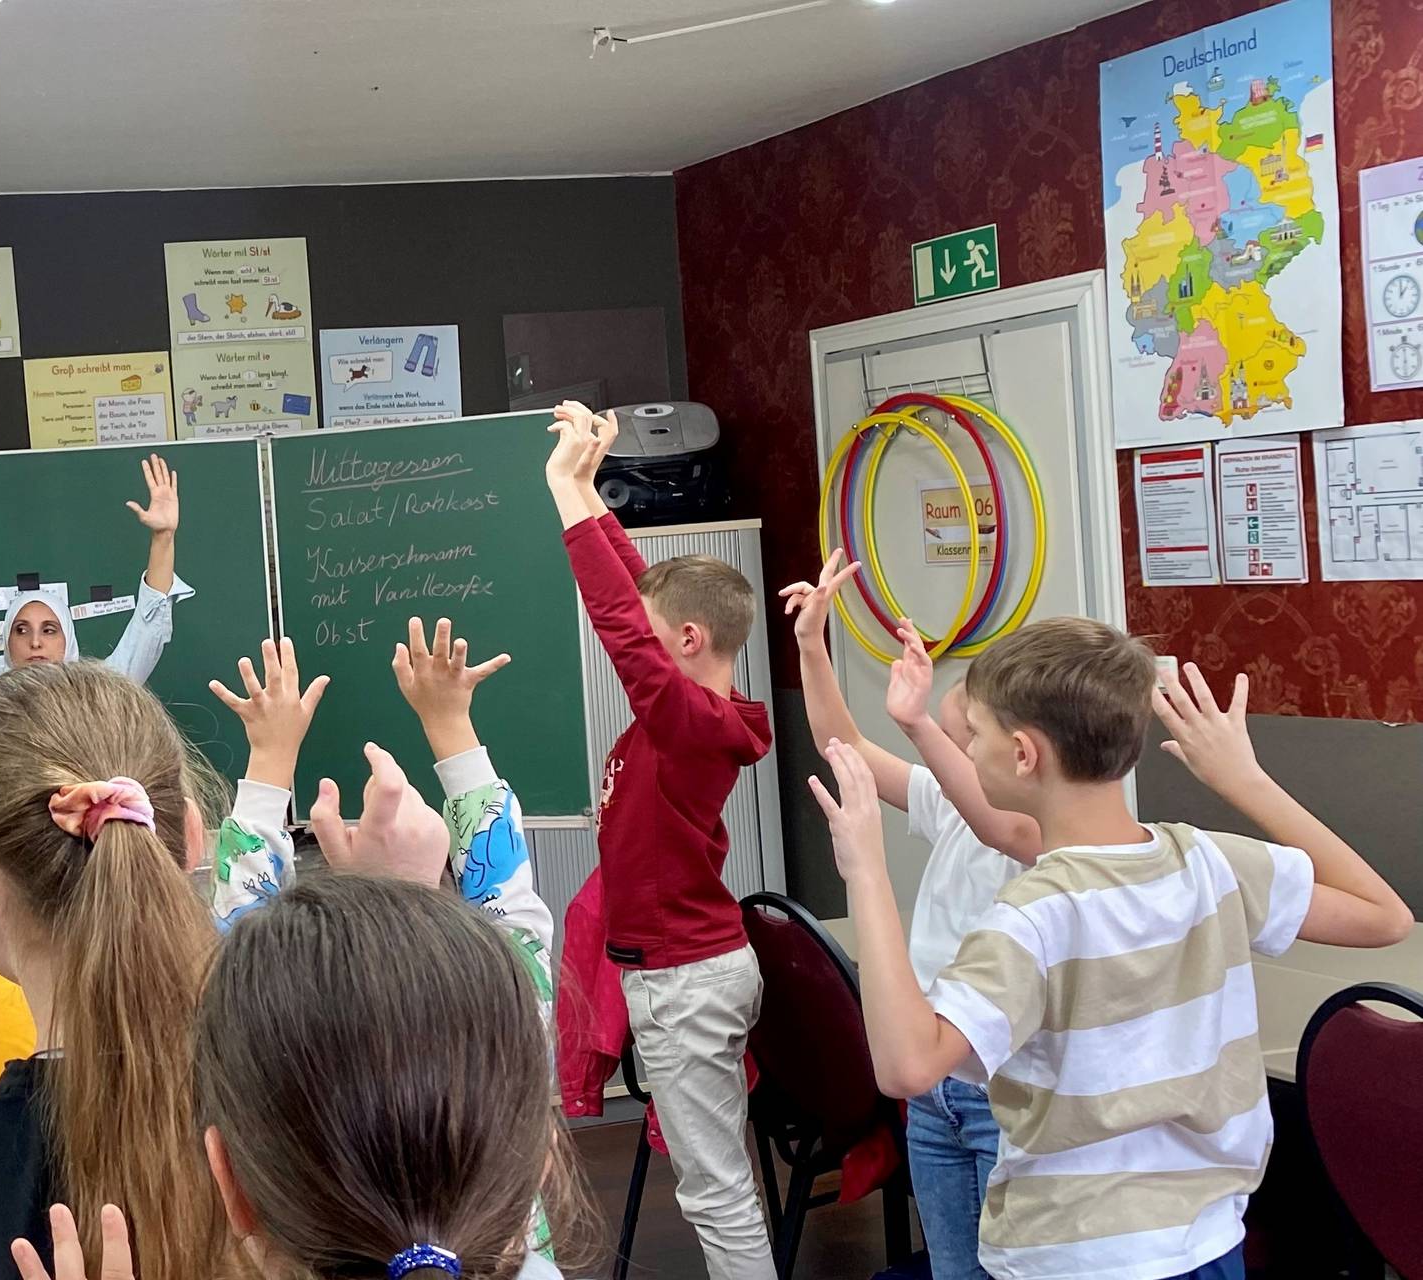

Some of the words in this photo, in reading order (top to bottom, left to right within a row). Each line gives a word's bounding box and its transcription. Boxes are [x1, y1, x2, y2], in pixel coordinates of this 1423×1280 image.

[1163, 28, 1257, 77] Deutschland
[202, 248, 232, 258] Wörter
[234, 247, 247, 257] mit
[359, 335, 403, 347] Verlängern
[216, 352, 245, 363] Wörter
[248, 351, 261, 361] mit
[52, 364, 74, 377] Groß
[77, 362, 110, 373] schreibt
[305, 447, 464, 491] Mittagessen
[926, 503, 961, 519] Raum
[311, 583, 351, 608] mit
[316, 617, 376, 647] Obst
